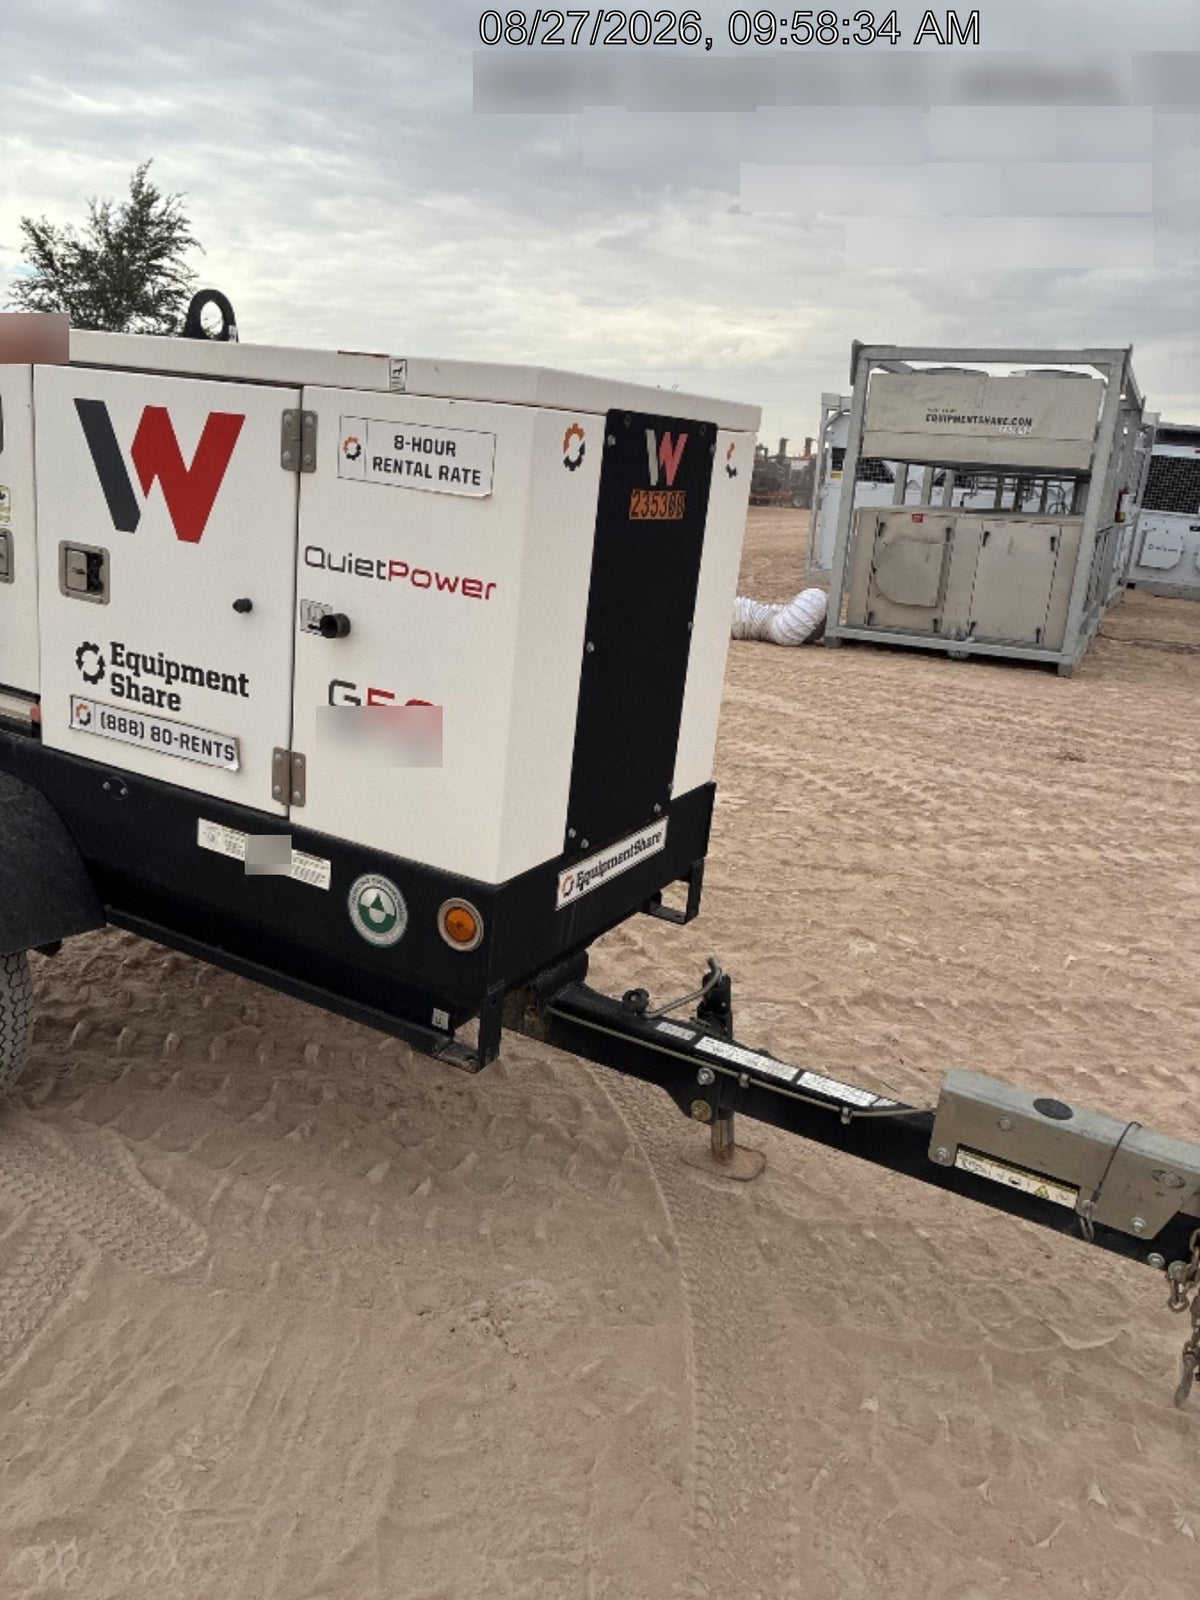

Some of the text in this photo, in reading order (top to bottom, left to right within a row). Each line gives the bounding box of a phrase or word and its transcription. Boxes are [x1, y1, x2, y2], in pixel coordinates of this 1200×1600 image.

[394, 434, 456, 458] 8-HOUR
[372, 456, 482, 486] RENTAL RATE
[304, 545, 497, 600] QuietPower
[109, 641, 250, 698] Equipment
[110, 671, 182, 712] Share
[100, 711, 235, 762] (888) 80-RENTS
